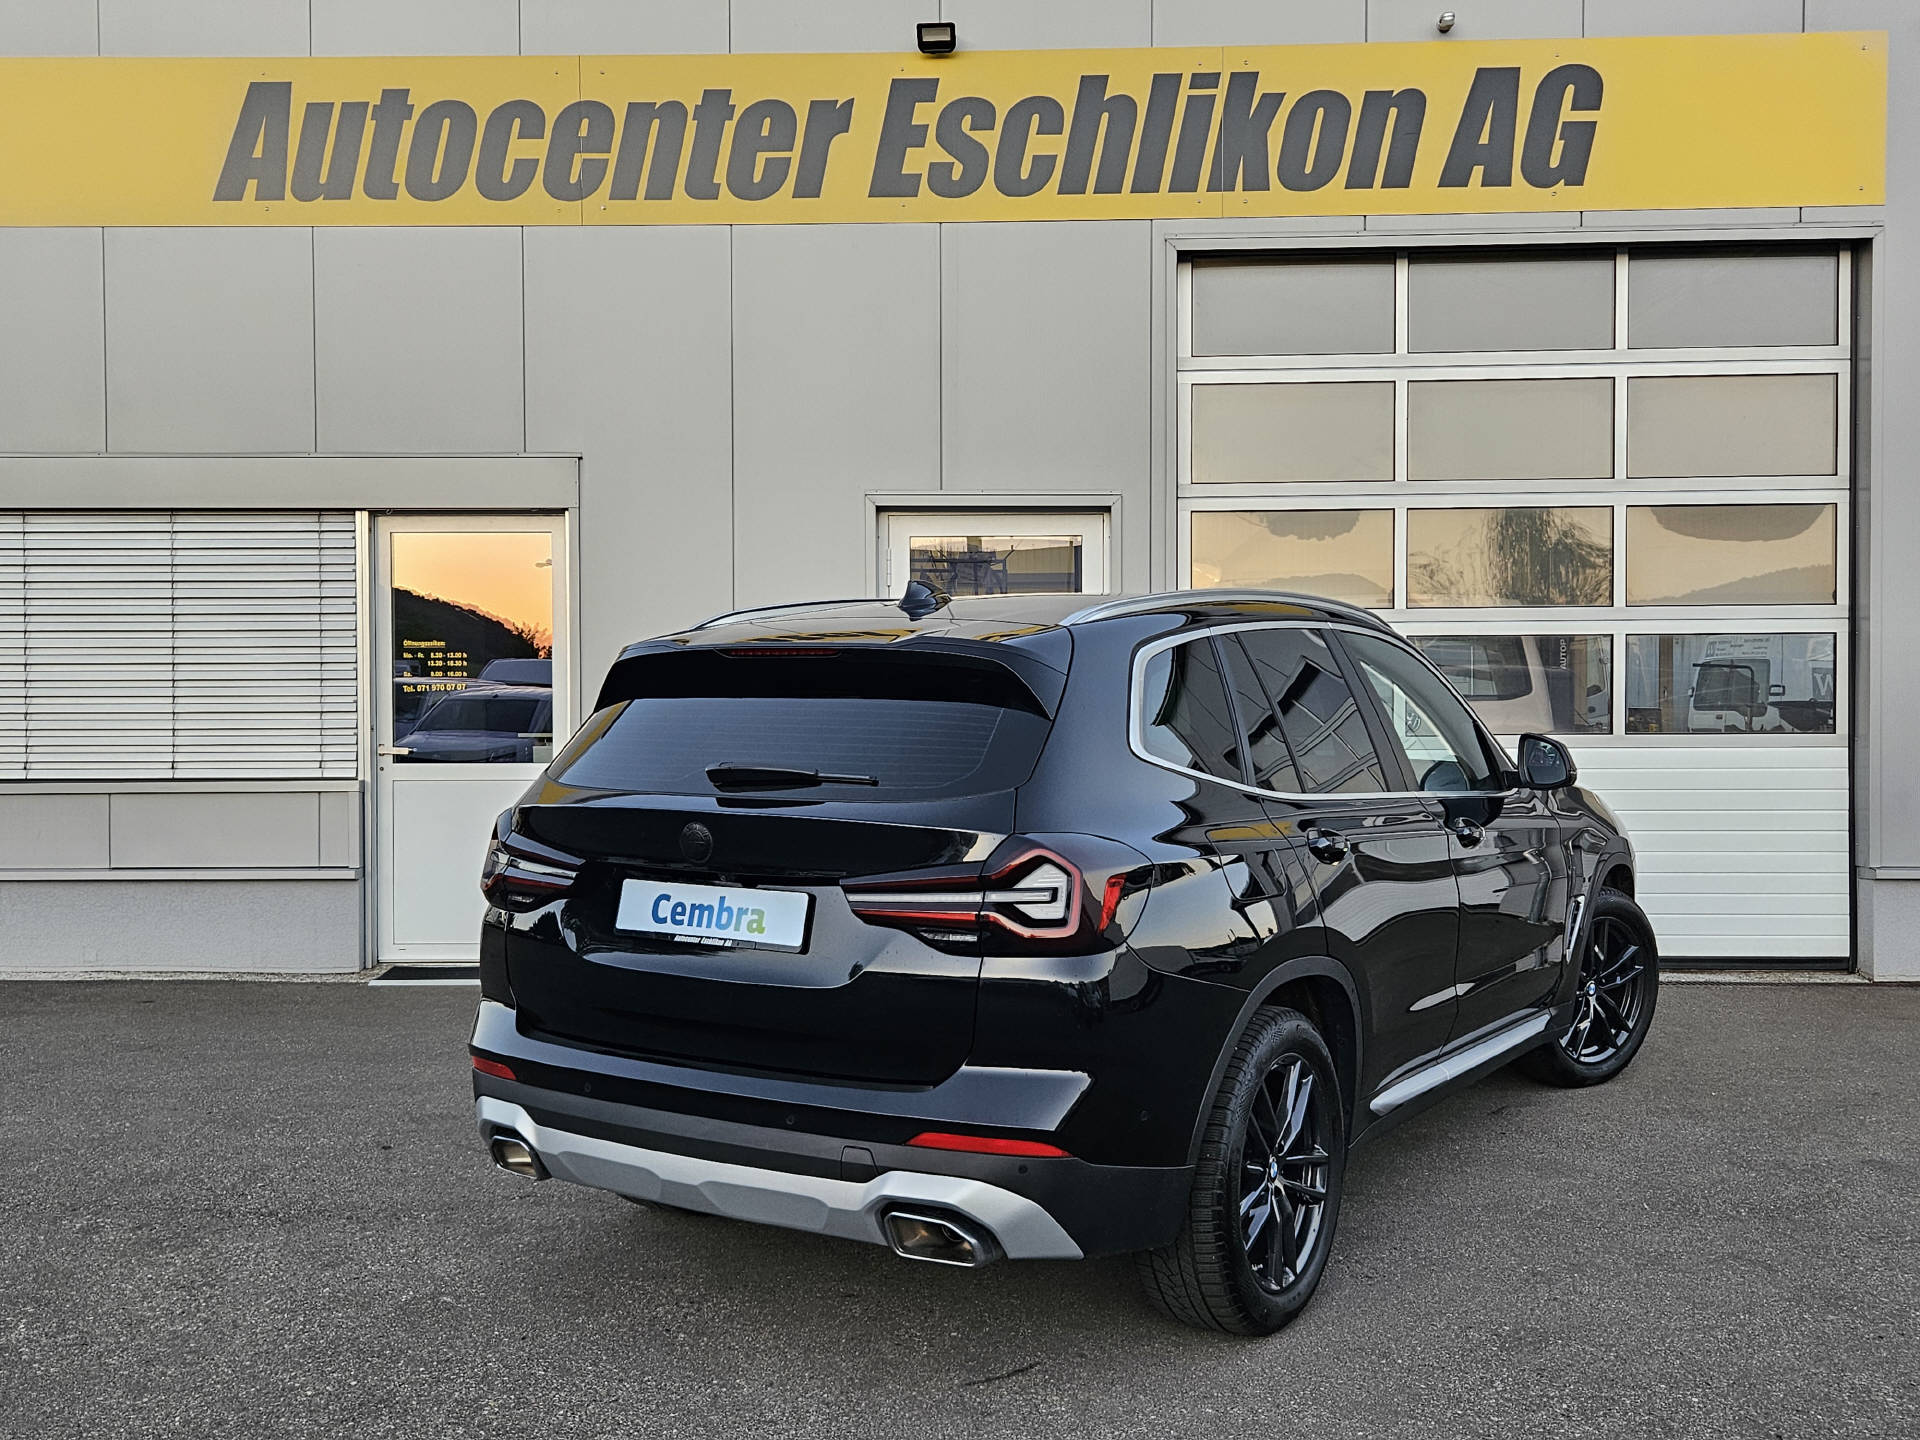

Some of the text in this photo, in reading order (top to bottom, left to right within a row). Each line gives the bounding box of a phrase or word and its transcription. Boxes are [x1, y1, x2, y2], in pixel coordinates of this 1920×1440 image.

[212, 62, 1603, 202] Autocenter Eschlikon AG
[402, 685, 416, 693] Tel.
[417, 684, 430, 692] 071
[446, 683, 456, 691] 07
[651, 893, 766, 935] Cembra
